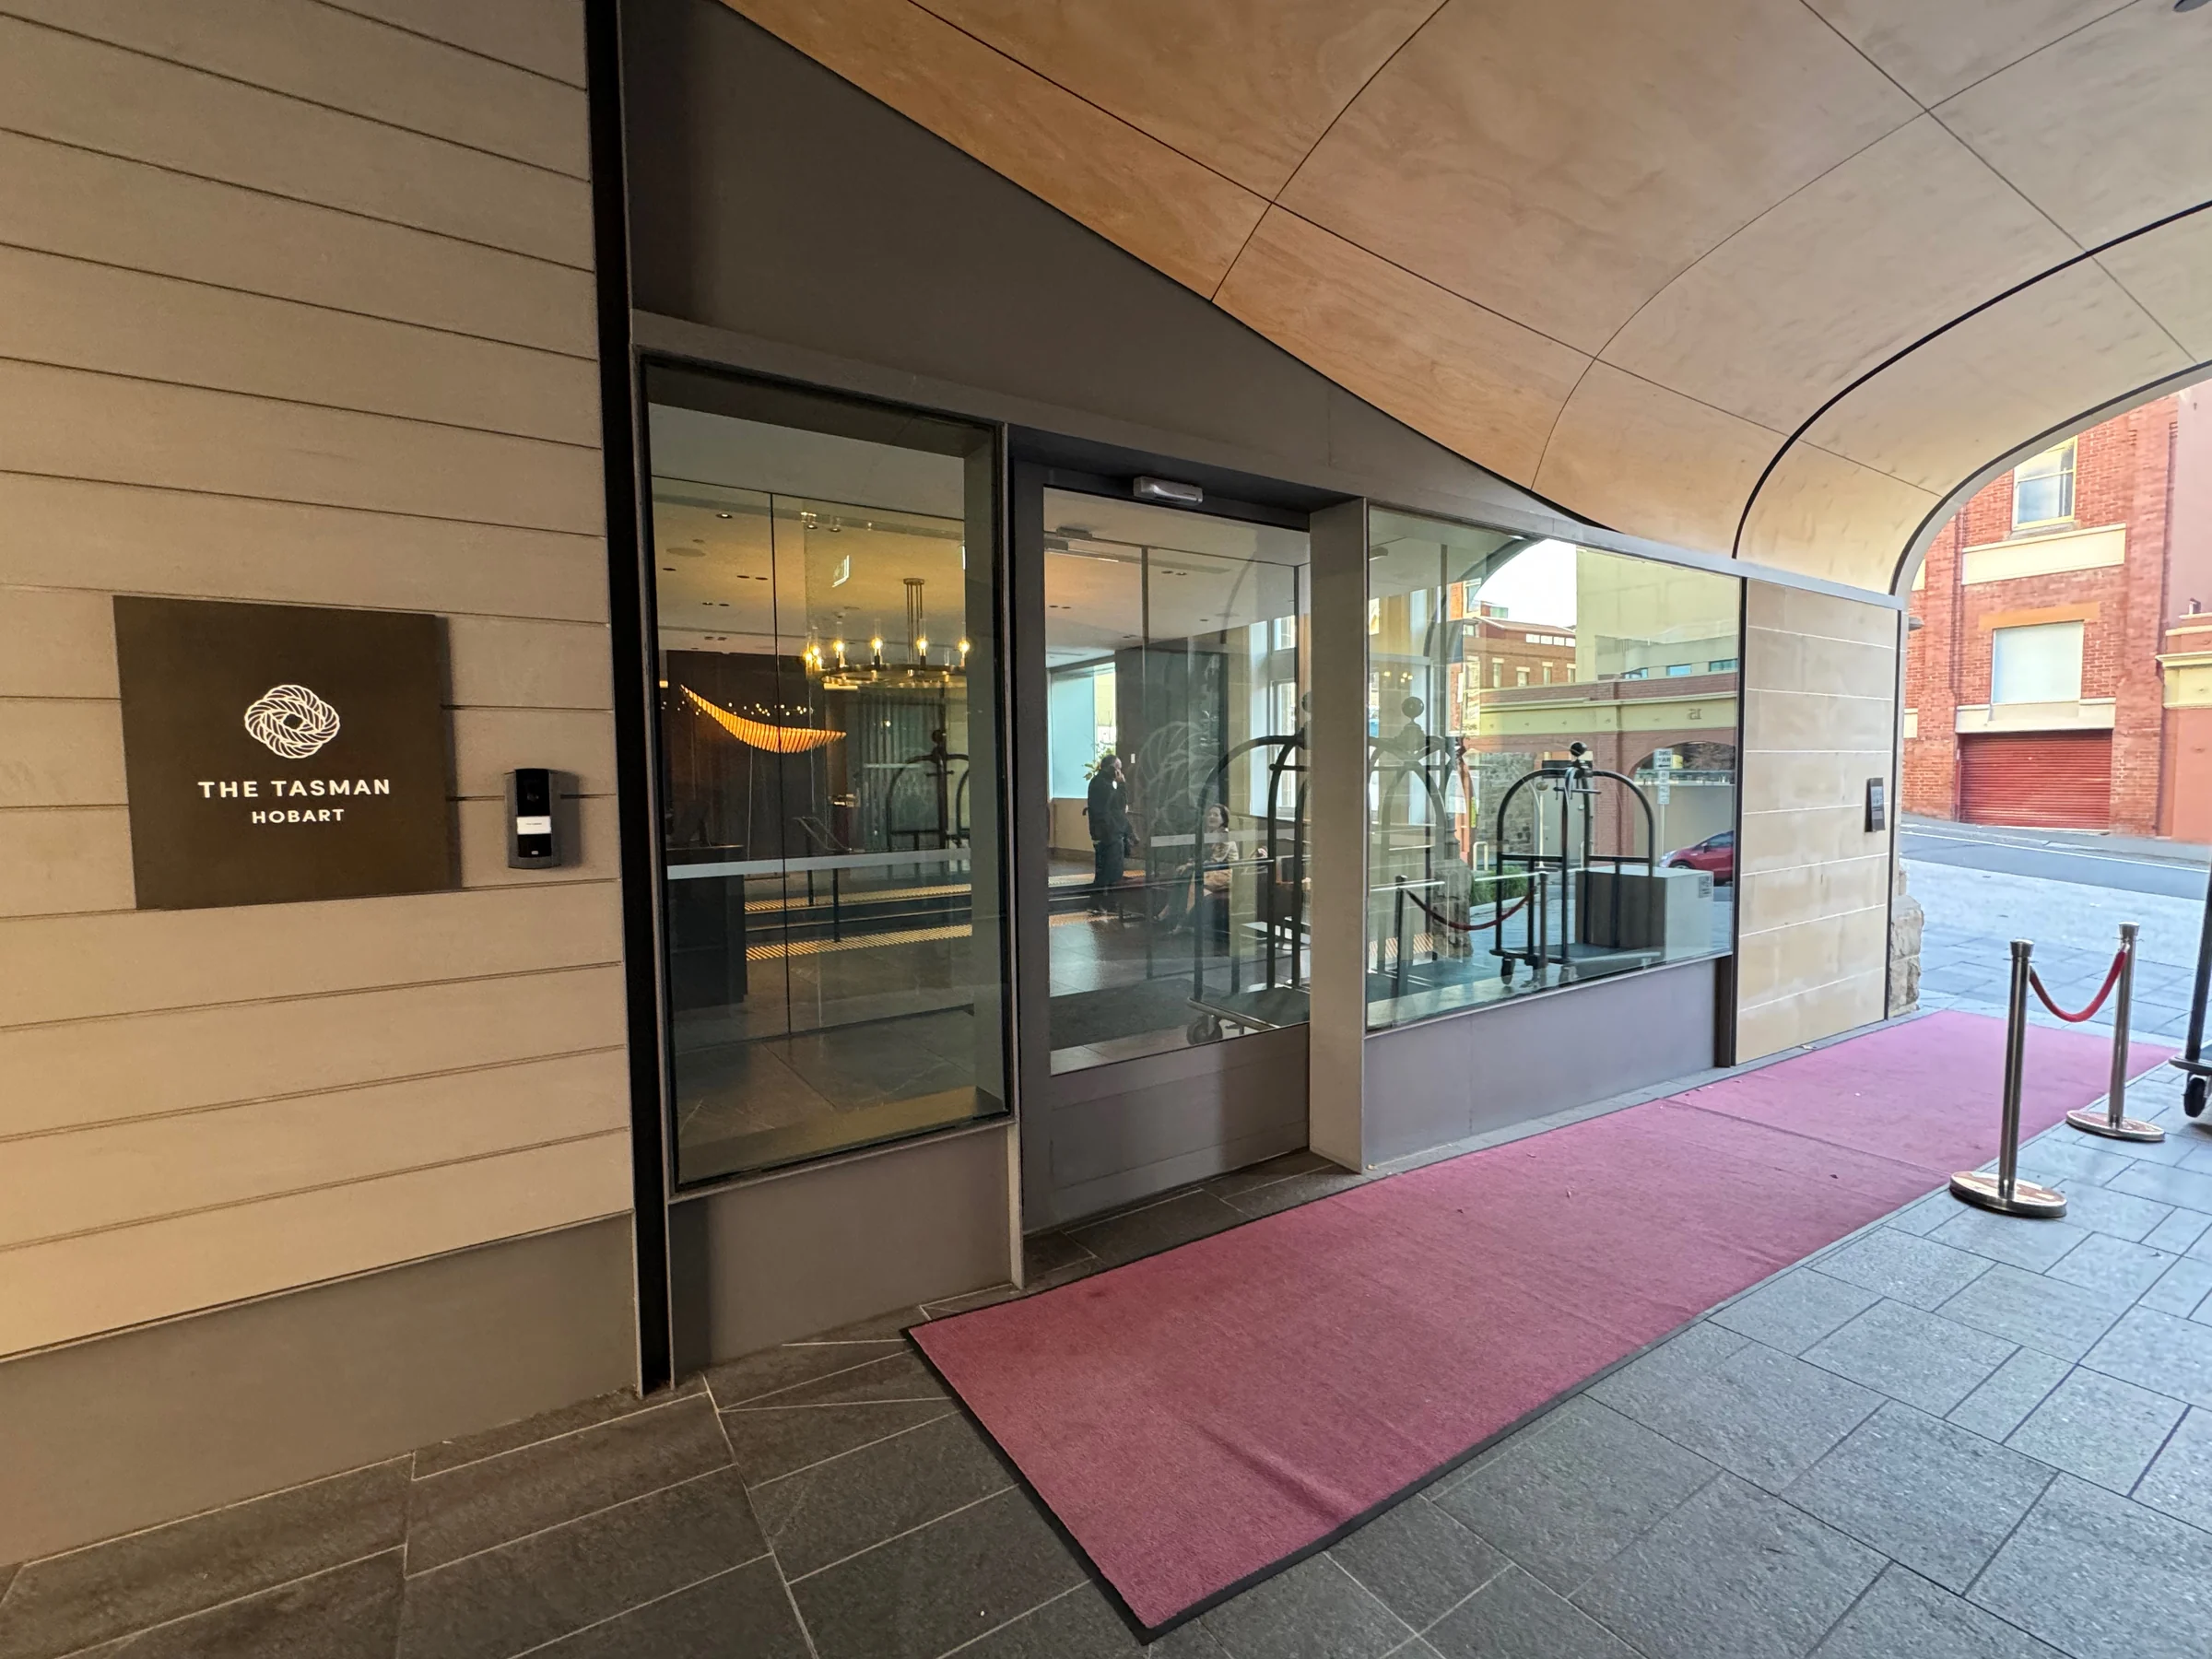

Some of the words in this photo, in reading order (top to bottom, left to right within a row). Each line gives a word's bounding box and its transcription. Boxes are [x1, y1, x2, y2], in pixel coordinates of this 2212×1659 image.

[197, 781, 259, 799] THE
[270, 779, 390, 797] TASMAN
[252, 808, 345, 824] HOBART
